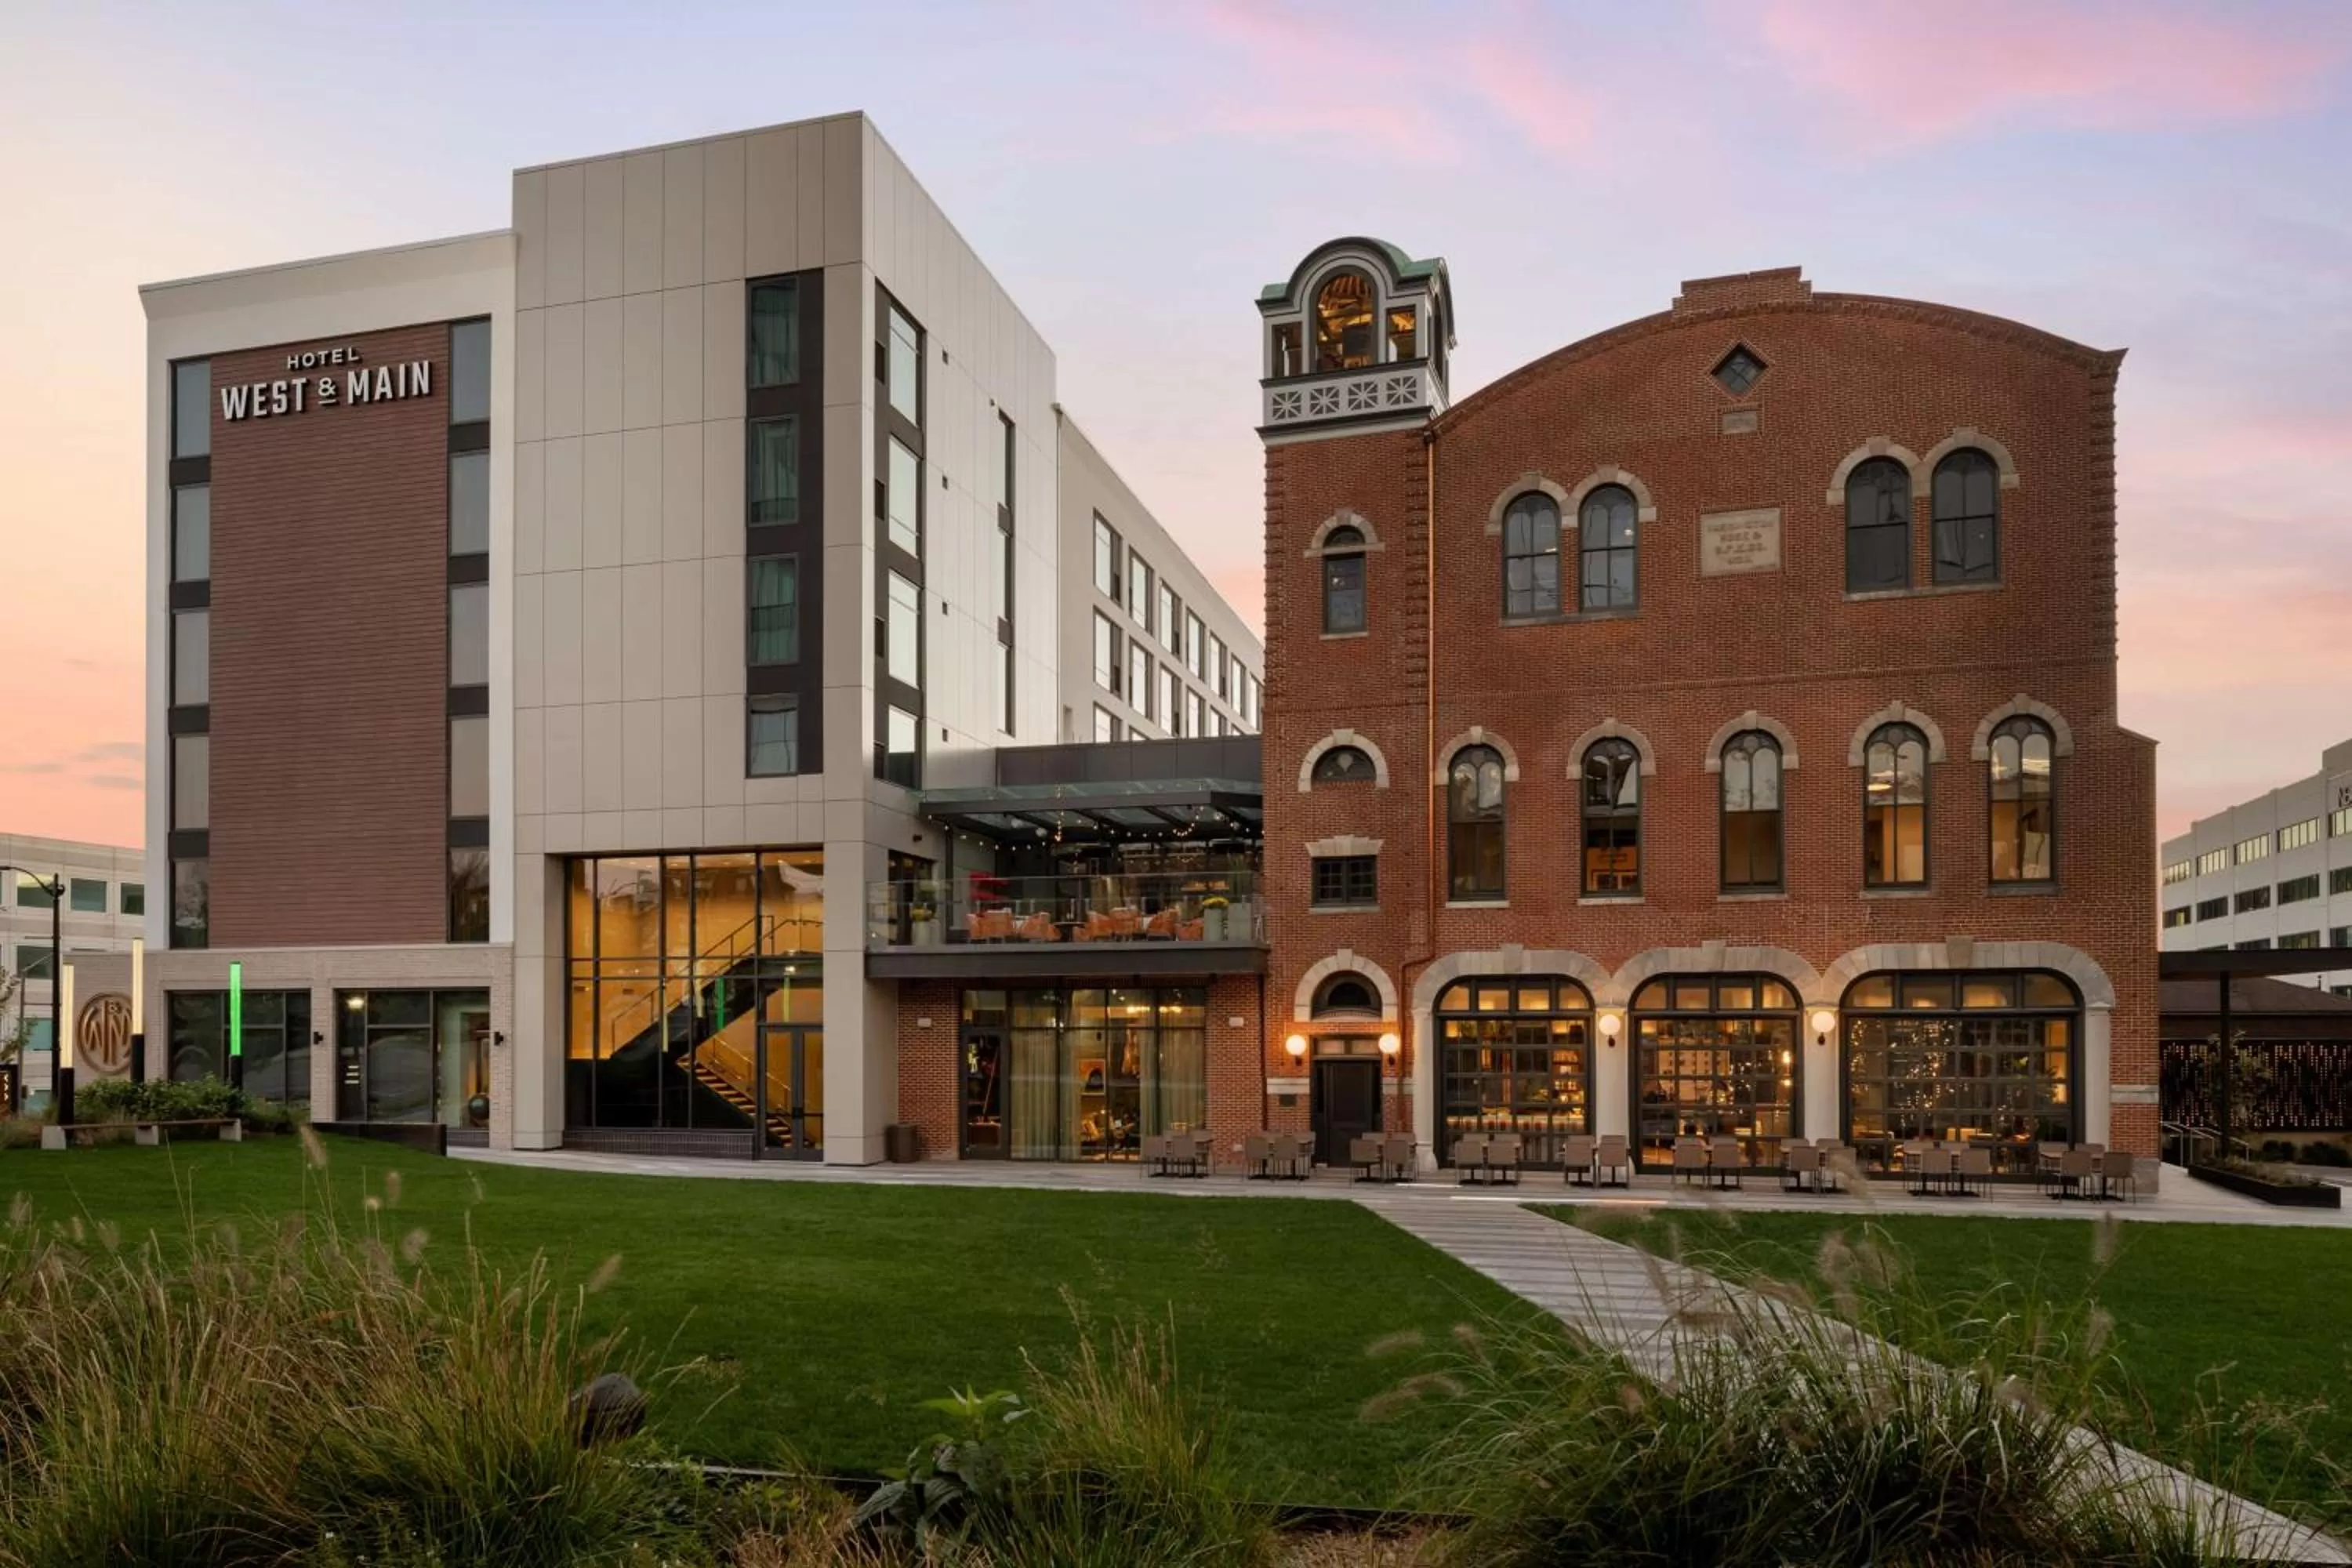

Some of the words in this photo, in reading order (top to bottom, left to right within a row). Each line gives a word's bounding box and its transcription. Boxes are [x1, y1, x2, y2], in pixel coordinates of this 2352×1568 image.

[287, 347, 360, 369] HOTEL
[220, 376, 308, 421] WEST
[318, 376, 336, 397] &
[347, 359, 430, 405] MAIN
